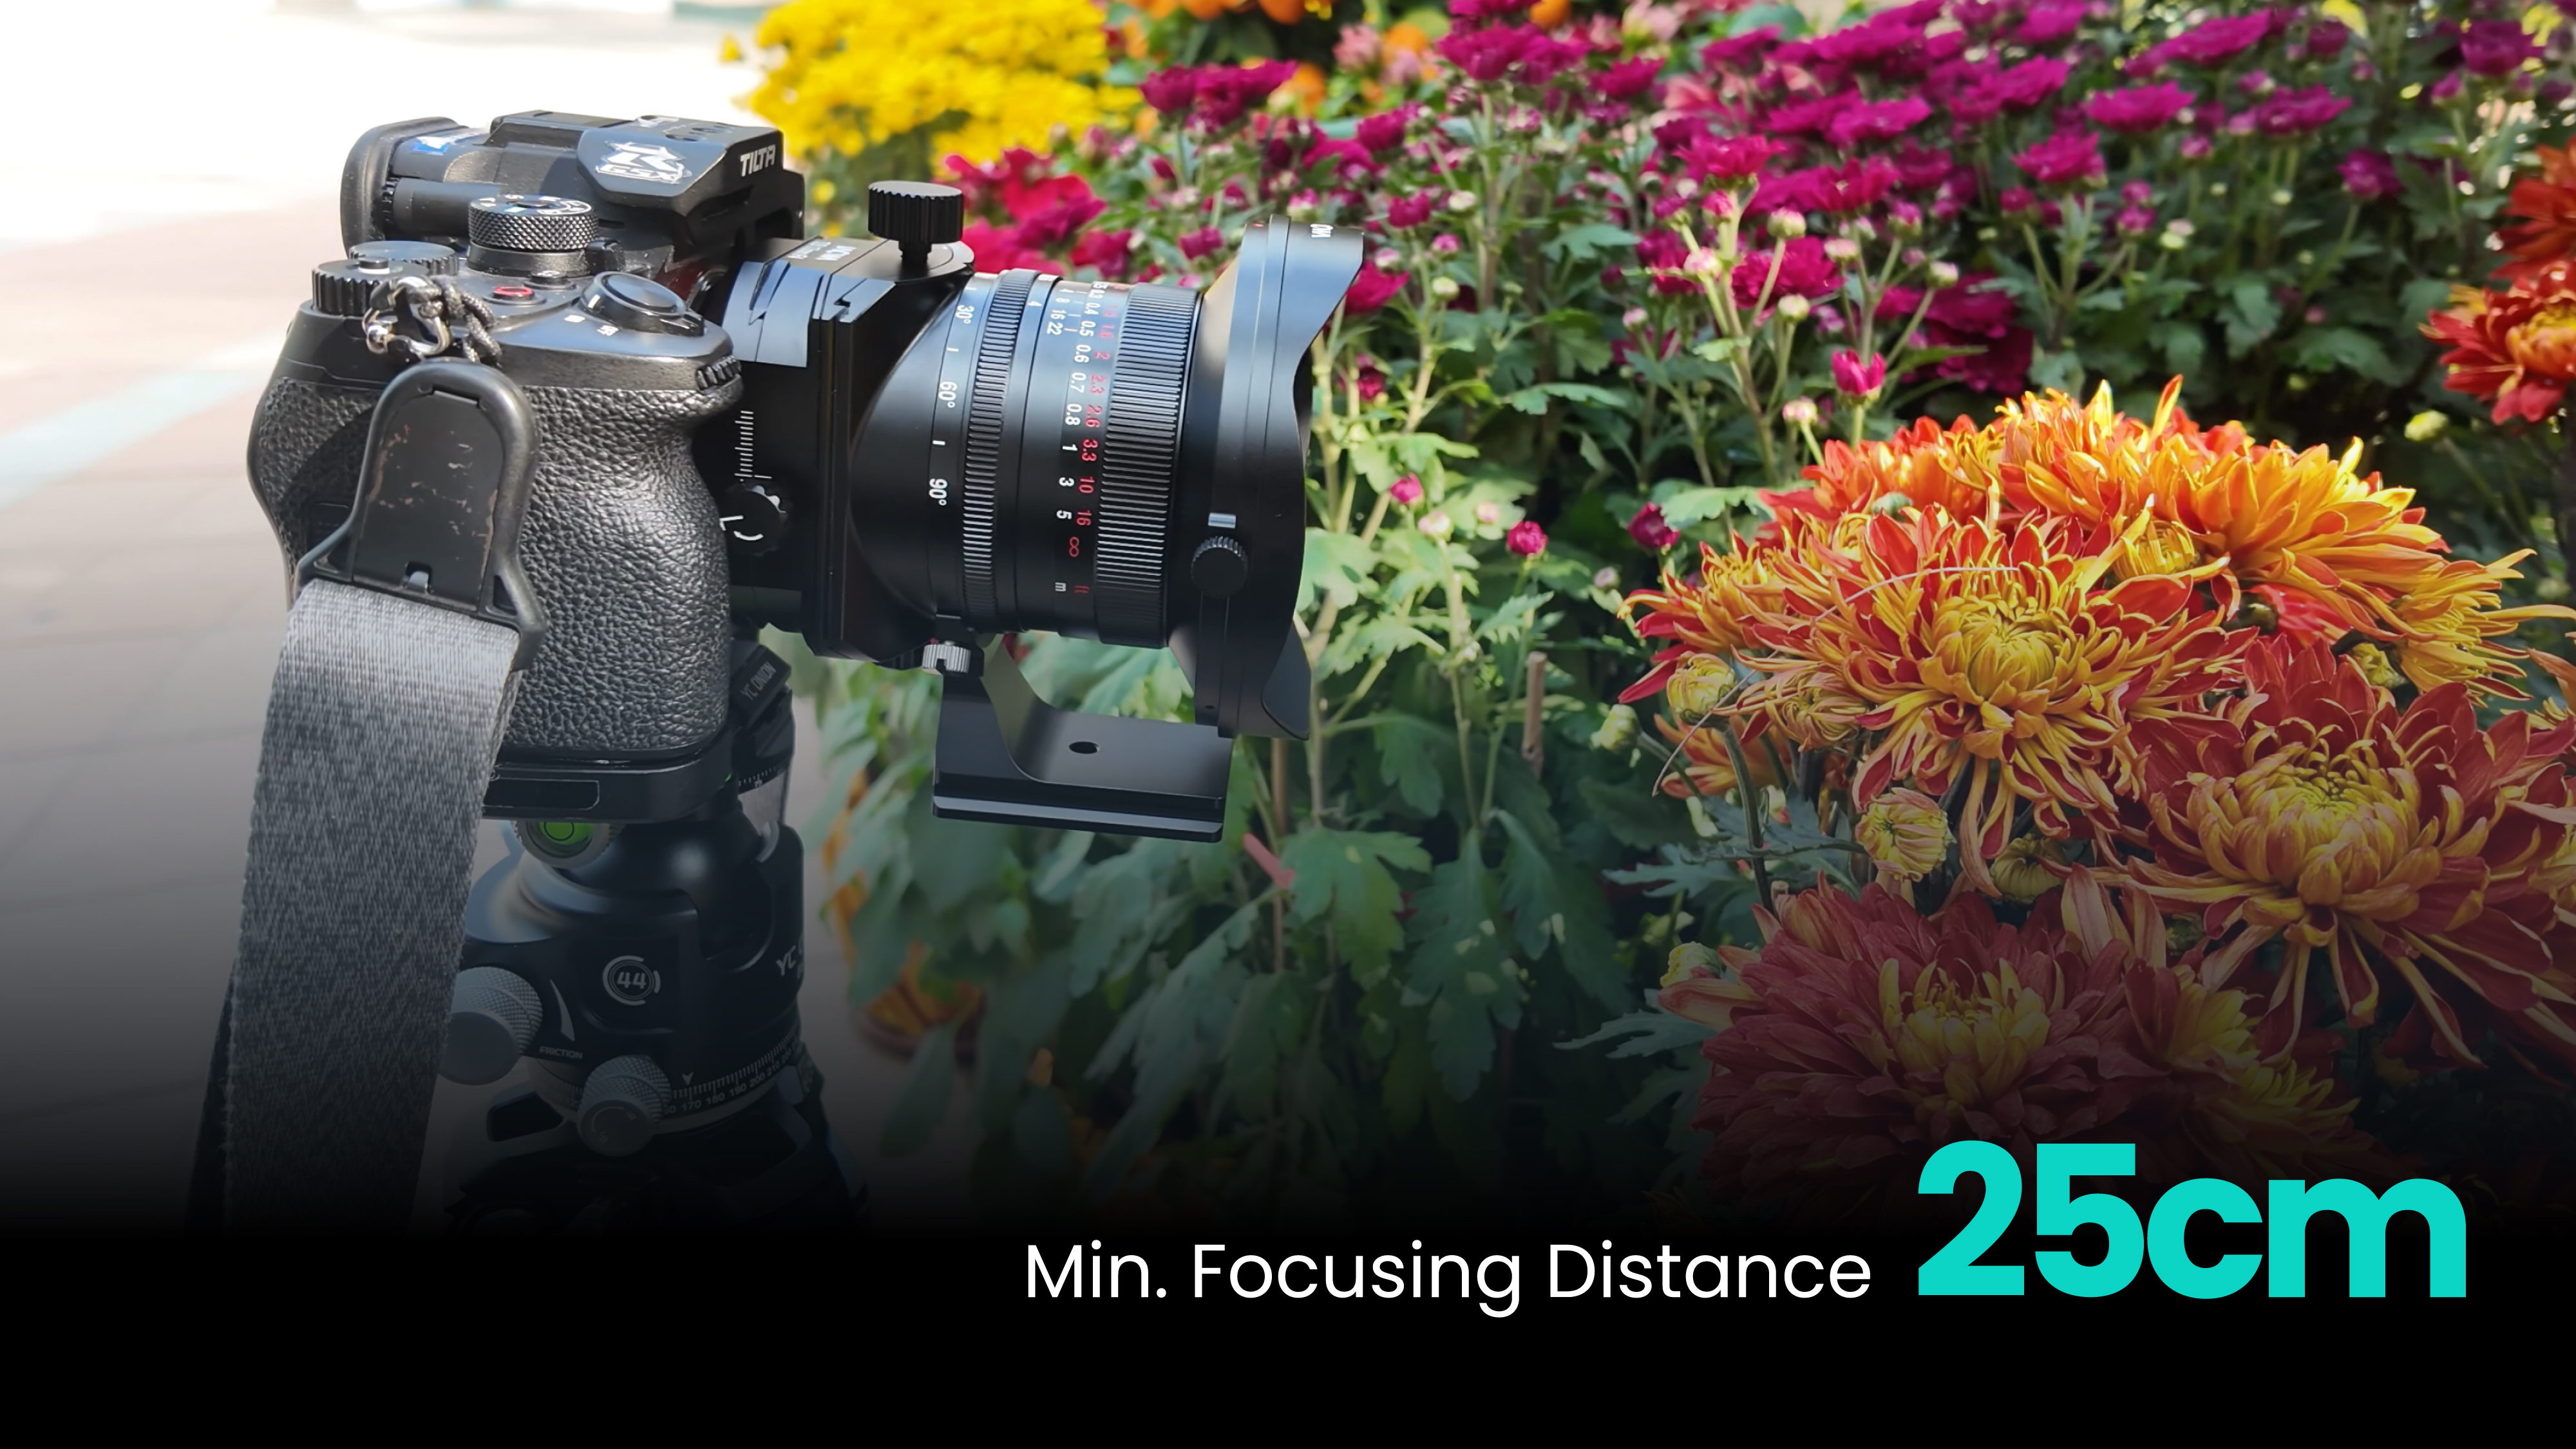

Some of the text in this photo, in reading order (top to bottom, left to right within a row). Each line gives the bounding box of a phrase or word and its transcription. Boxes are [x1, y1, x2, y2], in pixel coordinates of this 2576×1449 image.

[741, 144, 776, 178] TILTA
[1050, 309, 1066, 320] 16
[1084, 302, 1101, 316] 0.4
[1046, 321, 1063, 336] 22
[1079, 321, 1096, 337] 0.5
[1074, 344, 1092, 364] 0.6
[1095, 351, 1110, 360] 2
[1070, 372, 1086, 393] 0.7
[1089, 374, 1106, 395] 2.3
[929, 304, 975, 506] 30° 60° 90°
[1065, 403, 1083, 426] 0.8
[1084, 405, 1103, 428] 2.6
[1062, 443, 1077, 453] 1
[1081, 439, 1098, 462] 3.3
[1058, 477, 1075, 488] 3
[1078, 477, 1095, 494] 10
[1056, 510, 1072, 520] 5
[1076, 510, 1092, 526] 16
[1054, 582, 1066, 592] m
[741, 661, 777, 701] YC ONION
[616, 968, 647, 990] 44
[539, 1045, 583, 1060] FRICTION
[681, 1099, 702, 1112] 170
[706, 1092, 725, 1105] 180
[729, 1083, 747, 1096] 190
[749, 1071, 766, 1088] 200
[767, 1060, 781, 1077] 210
